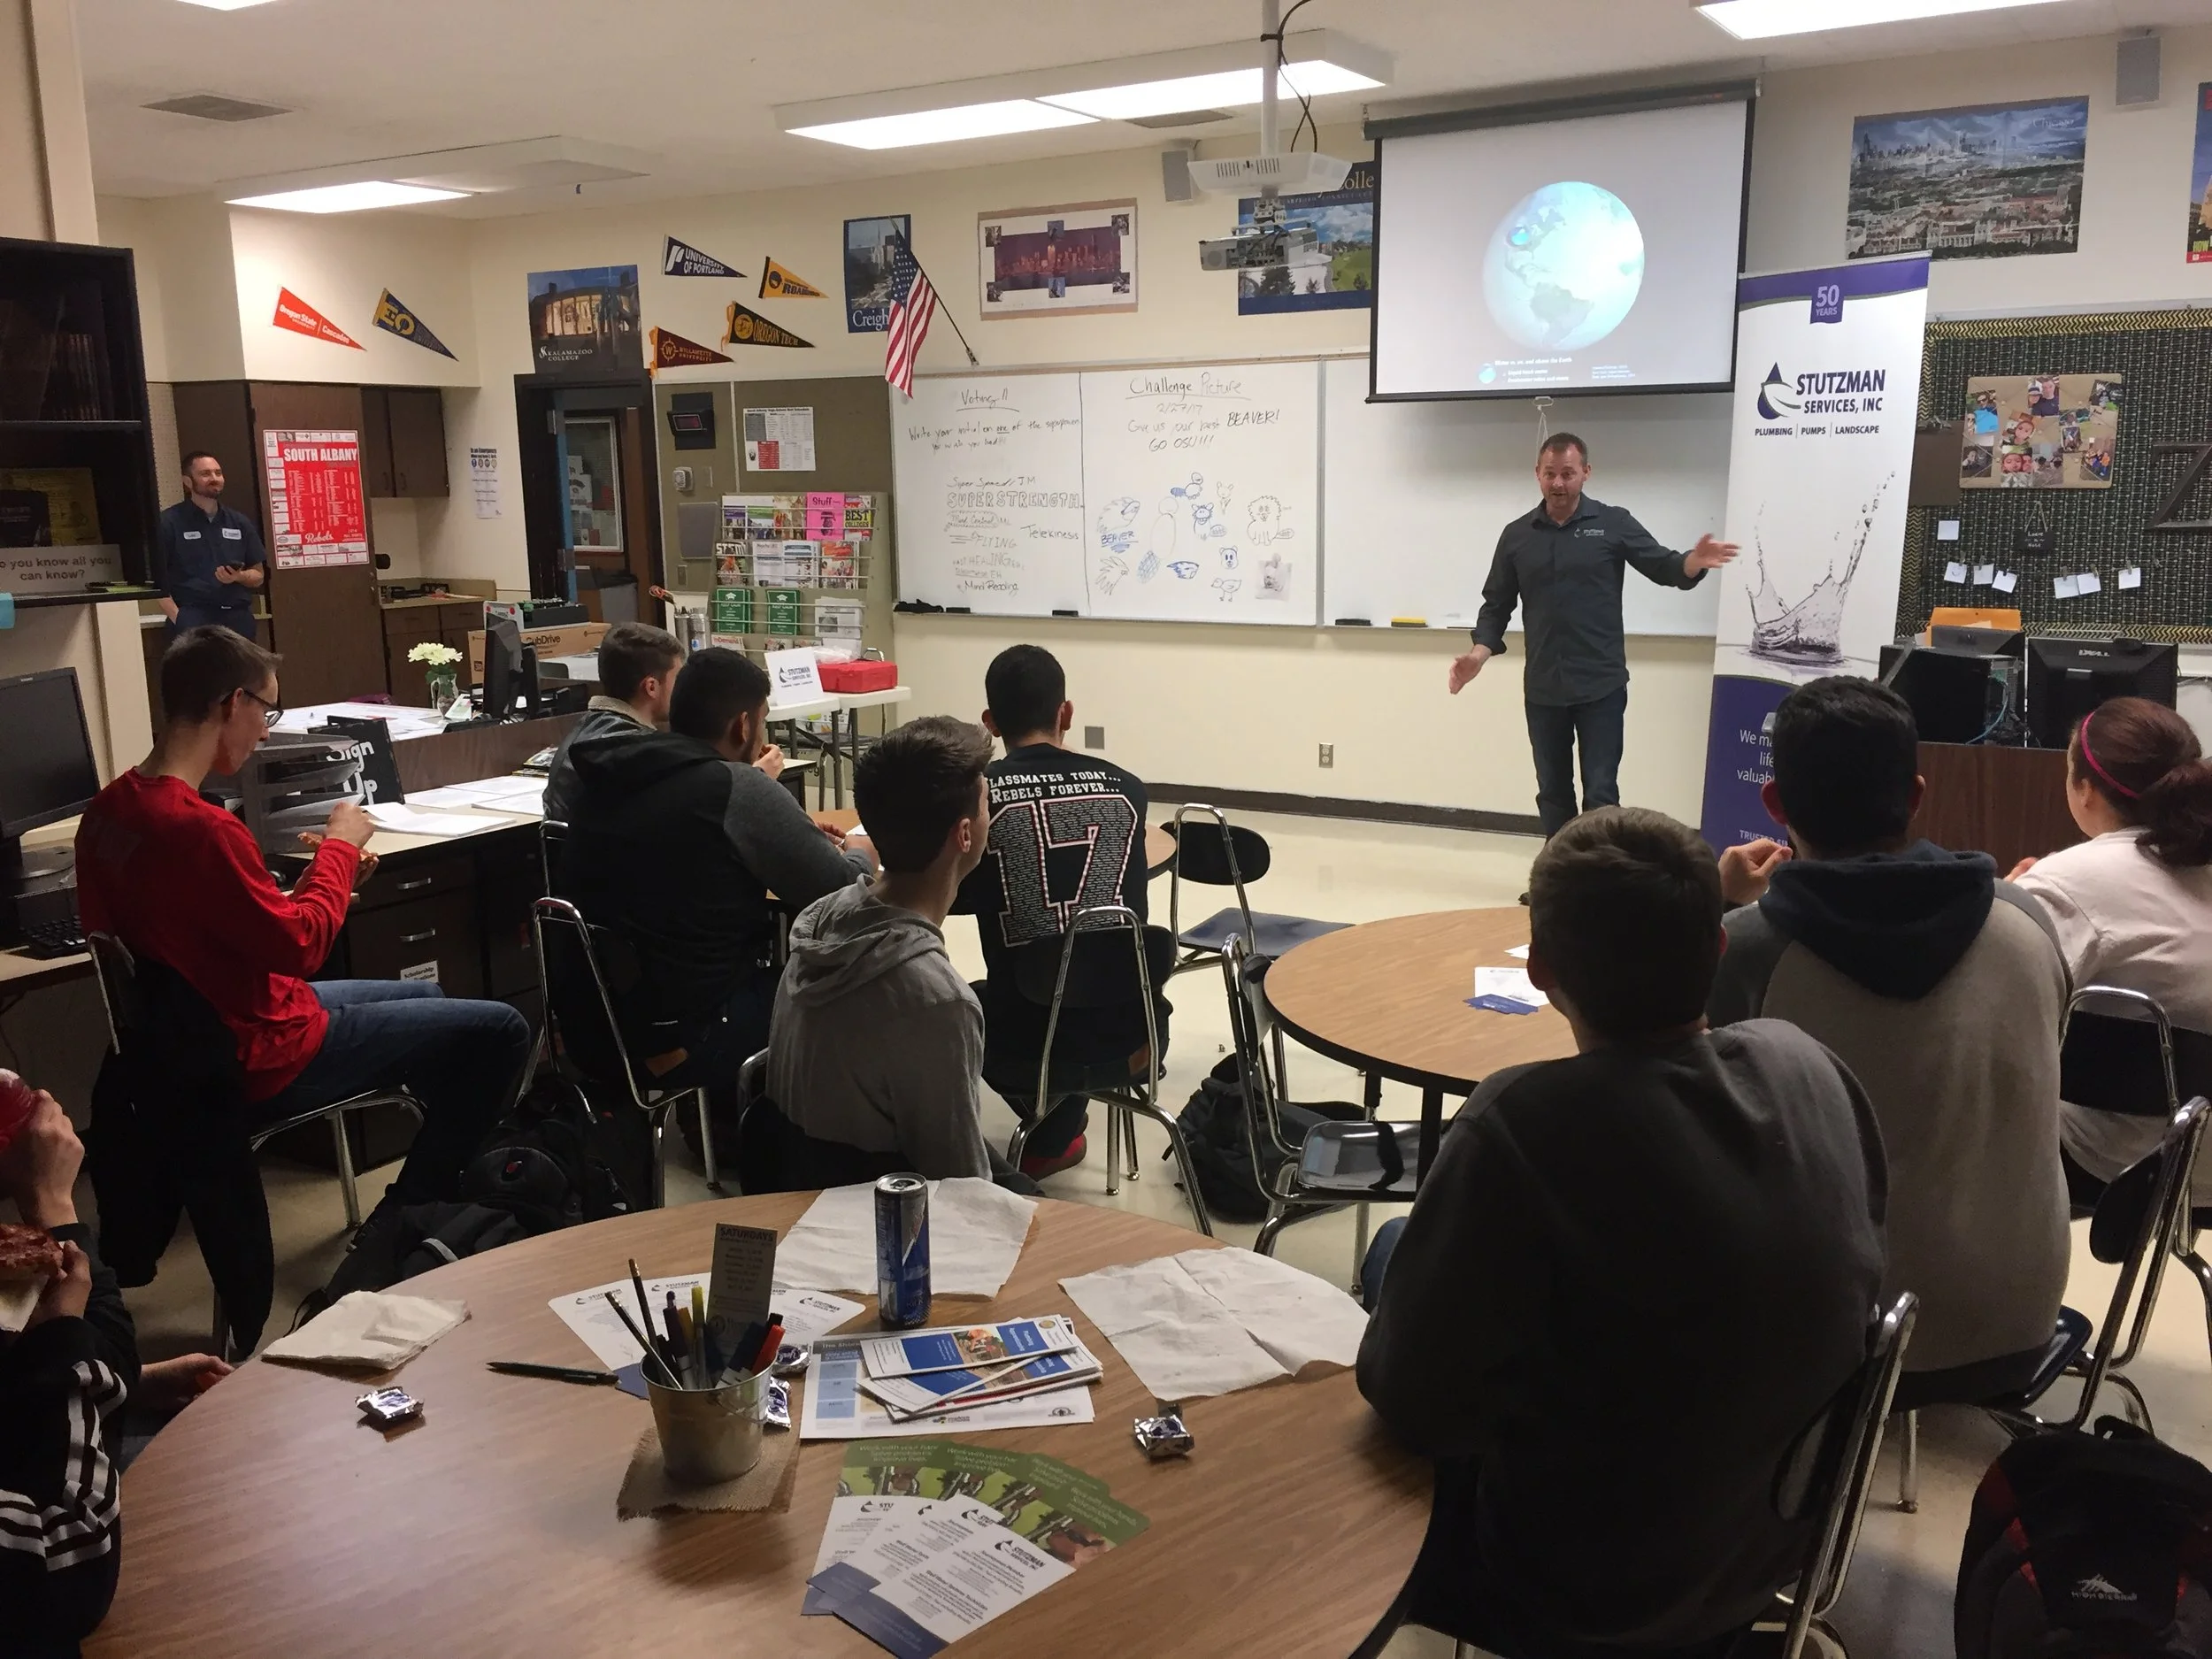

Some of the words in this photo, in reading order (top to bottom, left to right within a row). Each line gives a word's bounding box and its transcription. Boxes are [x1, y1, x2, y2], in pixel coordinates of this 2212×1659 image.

[685, 248, 725, 269] UNIVERSITY
[684, 261, 693, 274] OF
[693, 262, 725, 274] PORTLAND
[1816, 284, 1840, 308] 50
[1816, 307, 1838, 317] YEARS
[279, 303, 302, 319] Oregon
[301, 313, 318, 327] State
[321, 325, 350, 344] Cascades
[753, 319, 780, 343] OREGON
[780, 332, 799, 345] TECH
[1129, 376, 1193, 401] Challenge
[1200, 372, 1242, 397] Picture
[1795, 369, 1886, 396] STUTZMAN
[1803, 398, 1860, 414] SERVICES,
[1863, 397, 1883, 411] INC
[1755, 426, 1793, 436] PLUMBING
[1801, 426, 1826, 435] PUMPS
[1835, 425, 1879, 434] LANDSCAPE
[1149, 438, 1168, 452] GO
[283, 448, 319, 462] SOUTH
[319, 448, 357, 462] ALBANY
[812, 496, 833, 506] Stuff
[845, 509, 869, 521] BEST
[304, 531, 334, 543] Rebels
[1020, 524, 1079, 540] Telekinesis
[1101, 530, 1134, 545] BEAVER
[10, 558, 33, 570] you
[36, 557, 69, 567] know
[72, 556, 87, 566] all
[89, 557, 111, 568] you
[19, 572, 42, 580] can
[46, 569, 85, 580] know?
[2078, 649, 2110, 657] DELL
[1740, 729, 1756, 745] We
[326, 741, 375, 772] Sign
[985, 773, 1064, 789] LASSMATES
[1070, 771, 1122, 782] TODAY...
[342, 772, 378, 805] Up
[1048, 782, 1120, 795] FOREVER...
[987, 795, 1138, 947] 17
[720, 1227, 773, 1241] SATURDAYS
